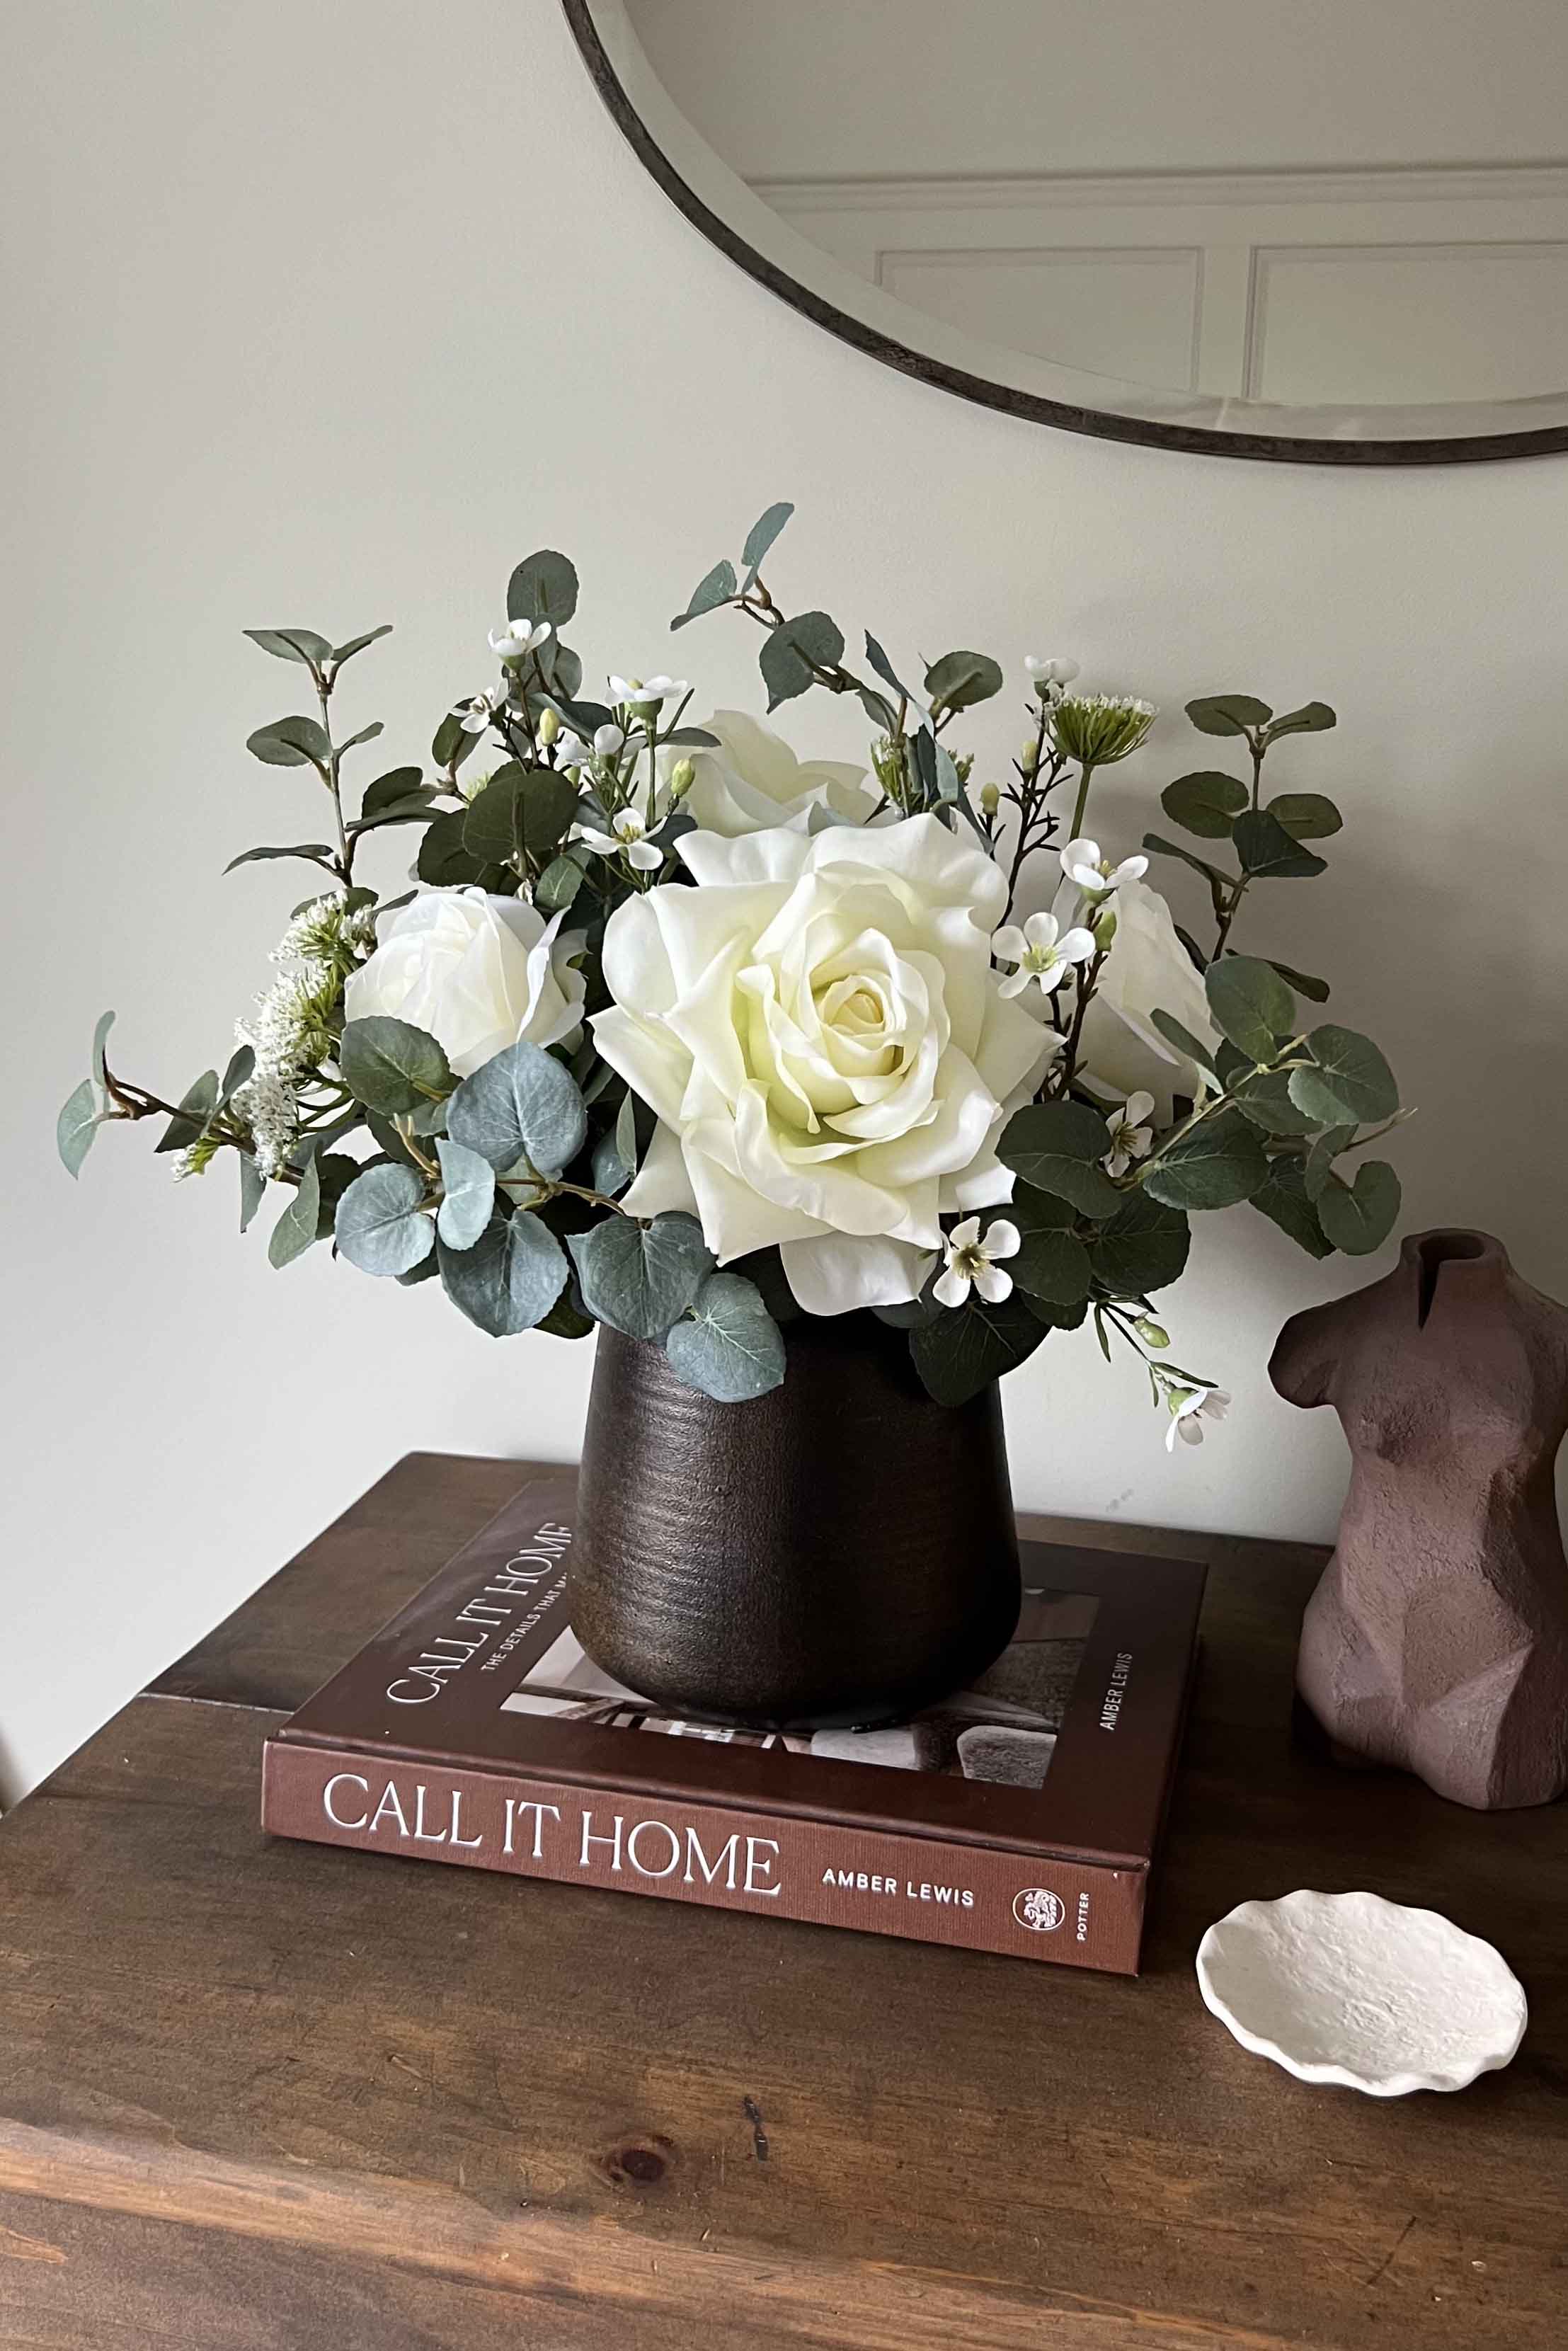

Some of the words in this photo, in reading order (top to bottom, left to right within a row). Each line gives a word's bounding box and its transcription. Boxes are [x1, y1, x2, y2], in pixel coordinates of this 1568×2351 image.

[387, 1632, 489, 1703] CALL
[455, 1598, 512, 1626] IT
[481, 1652, 507, 1671] THE
[500, 1613, 541, 1651] DETAILS
[533, 1589, 561, 1611] THAT
[1110, 1653, 1133, 1686] LEWIS
[1099, 1688, 1123, 1731] AMBER
[323, 1773, 483, 1848] CALL
[503, 1799, 561, 1858] IT
[579, 1810, 782, 1896] HOME
[822, 1868, 897, 1894] AMBER
[907, 1880, 974, 1907] LEWIS
[1076, 1892, 1089, 1941] POTTER
